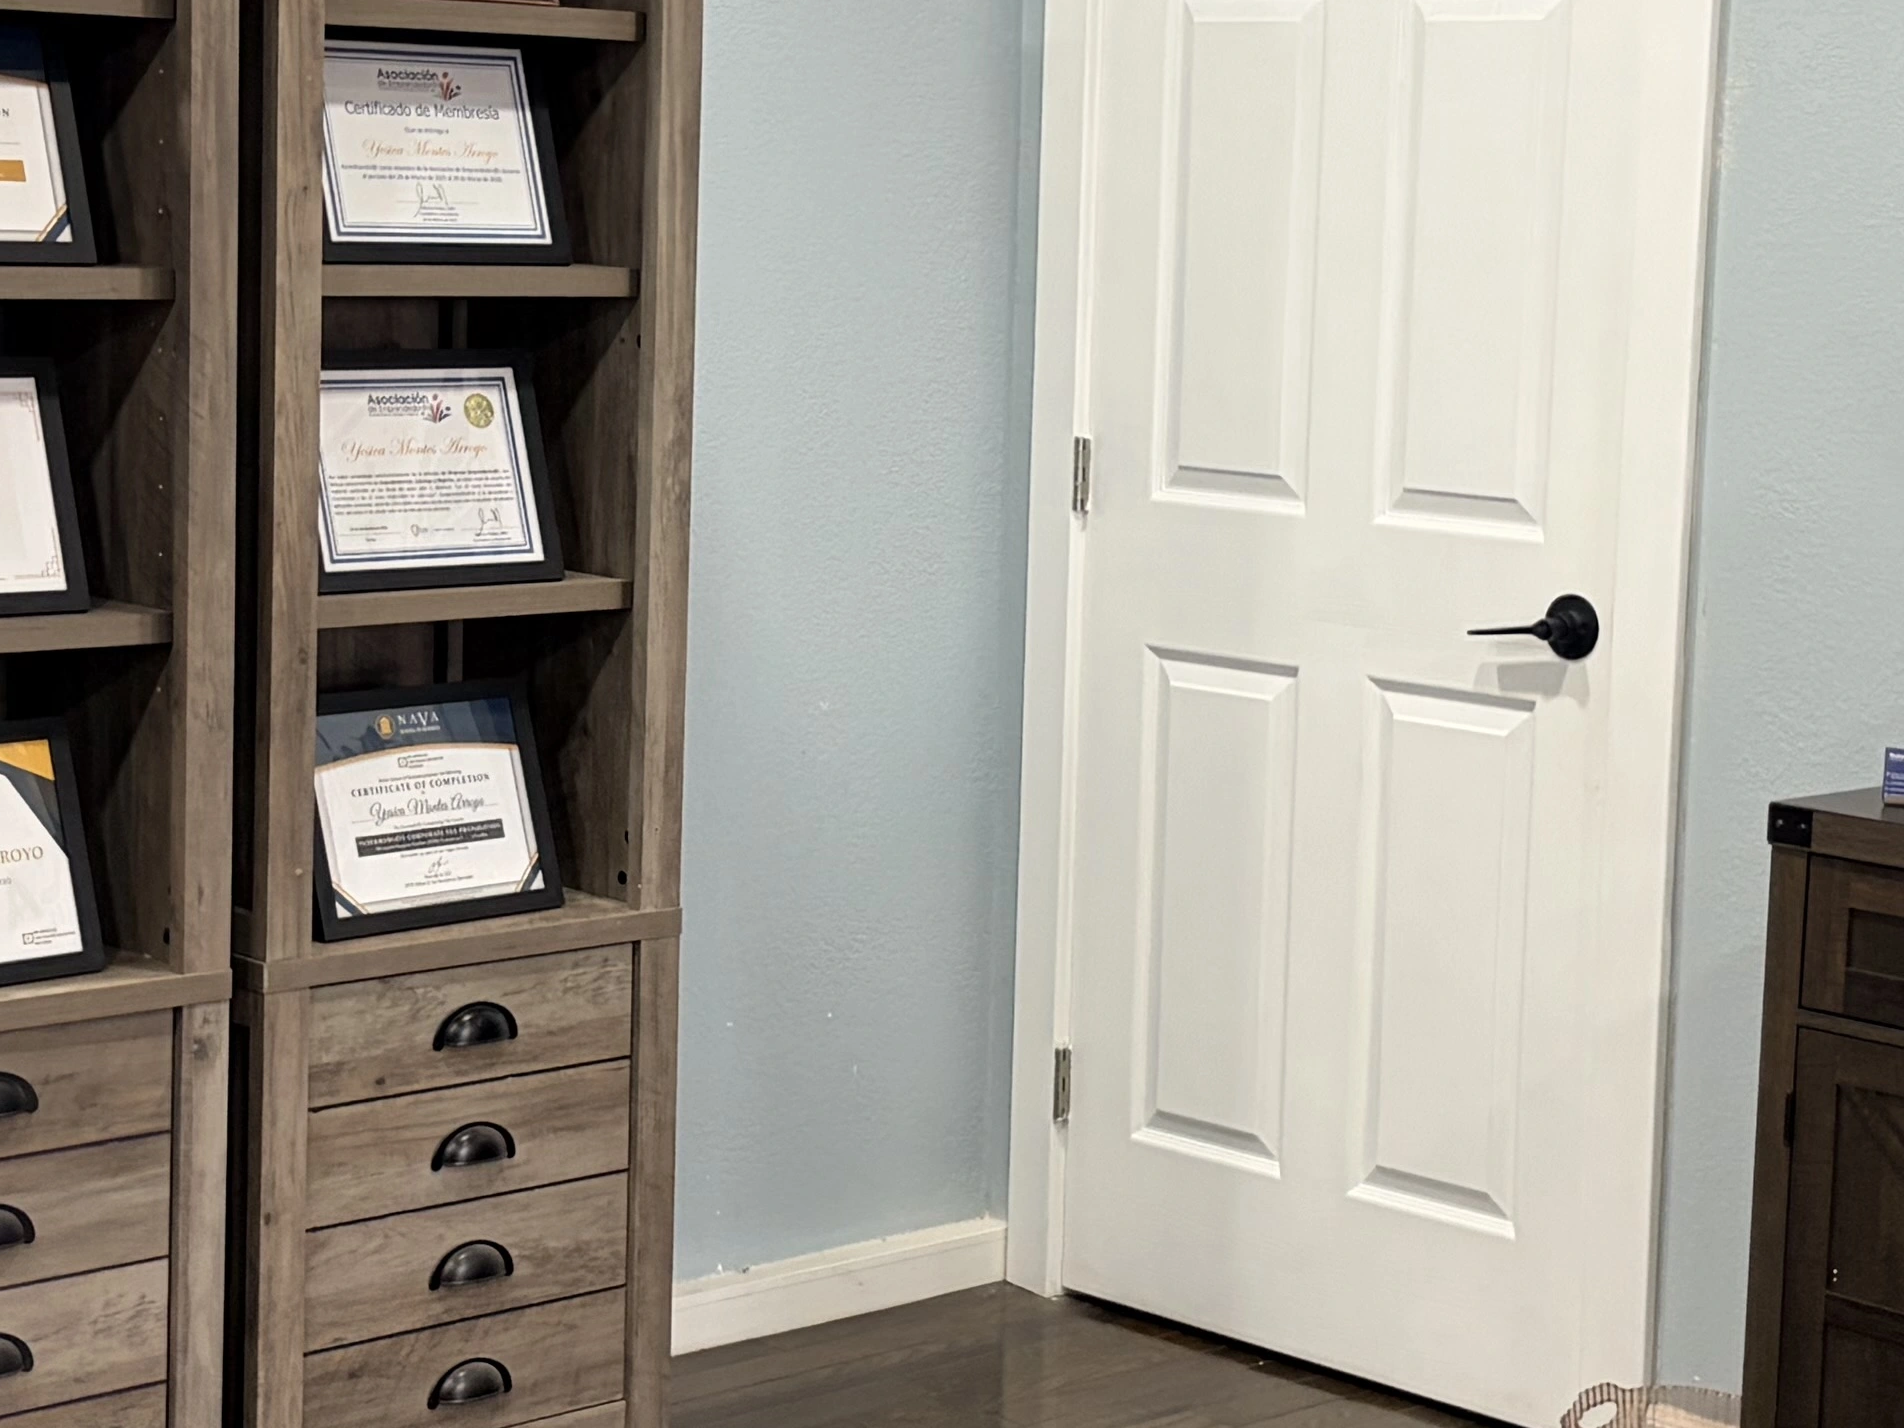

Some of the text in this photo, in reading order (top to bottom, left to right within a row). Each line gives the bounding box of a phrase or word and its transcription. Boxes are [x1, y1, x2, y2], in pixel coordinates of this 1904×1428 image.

[377, 68, 438, 82] Asociación
[345, 100, 499, 121] Certificado de Membresía
[367, 392, 428, 405] Asociación
[397, 712, 440, 727] NAVA
[351, 783, 411, 798] CERTIFICATE
[429, 773, 490, 789] COMPLETION
